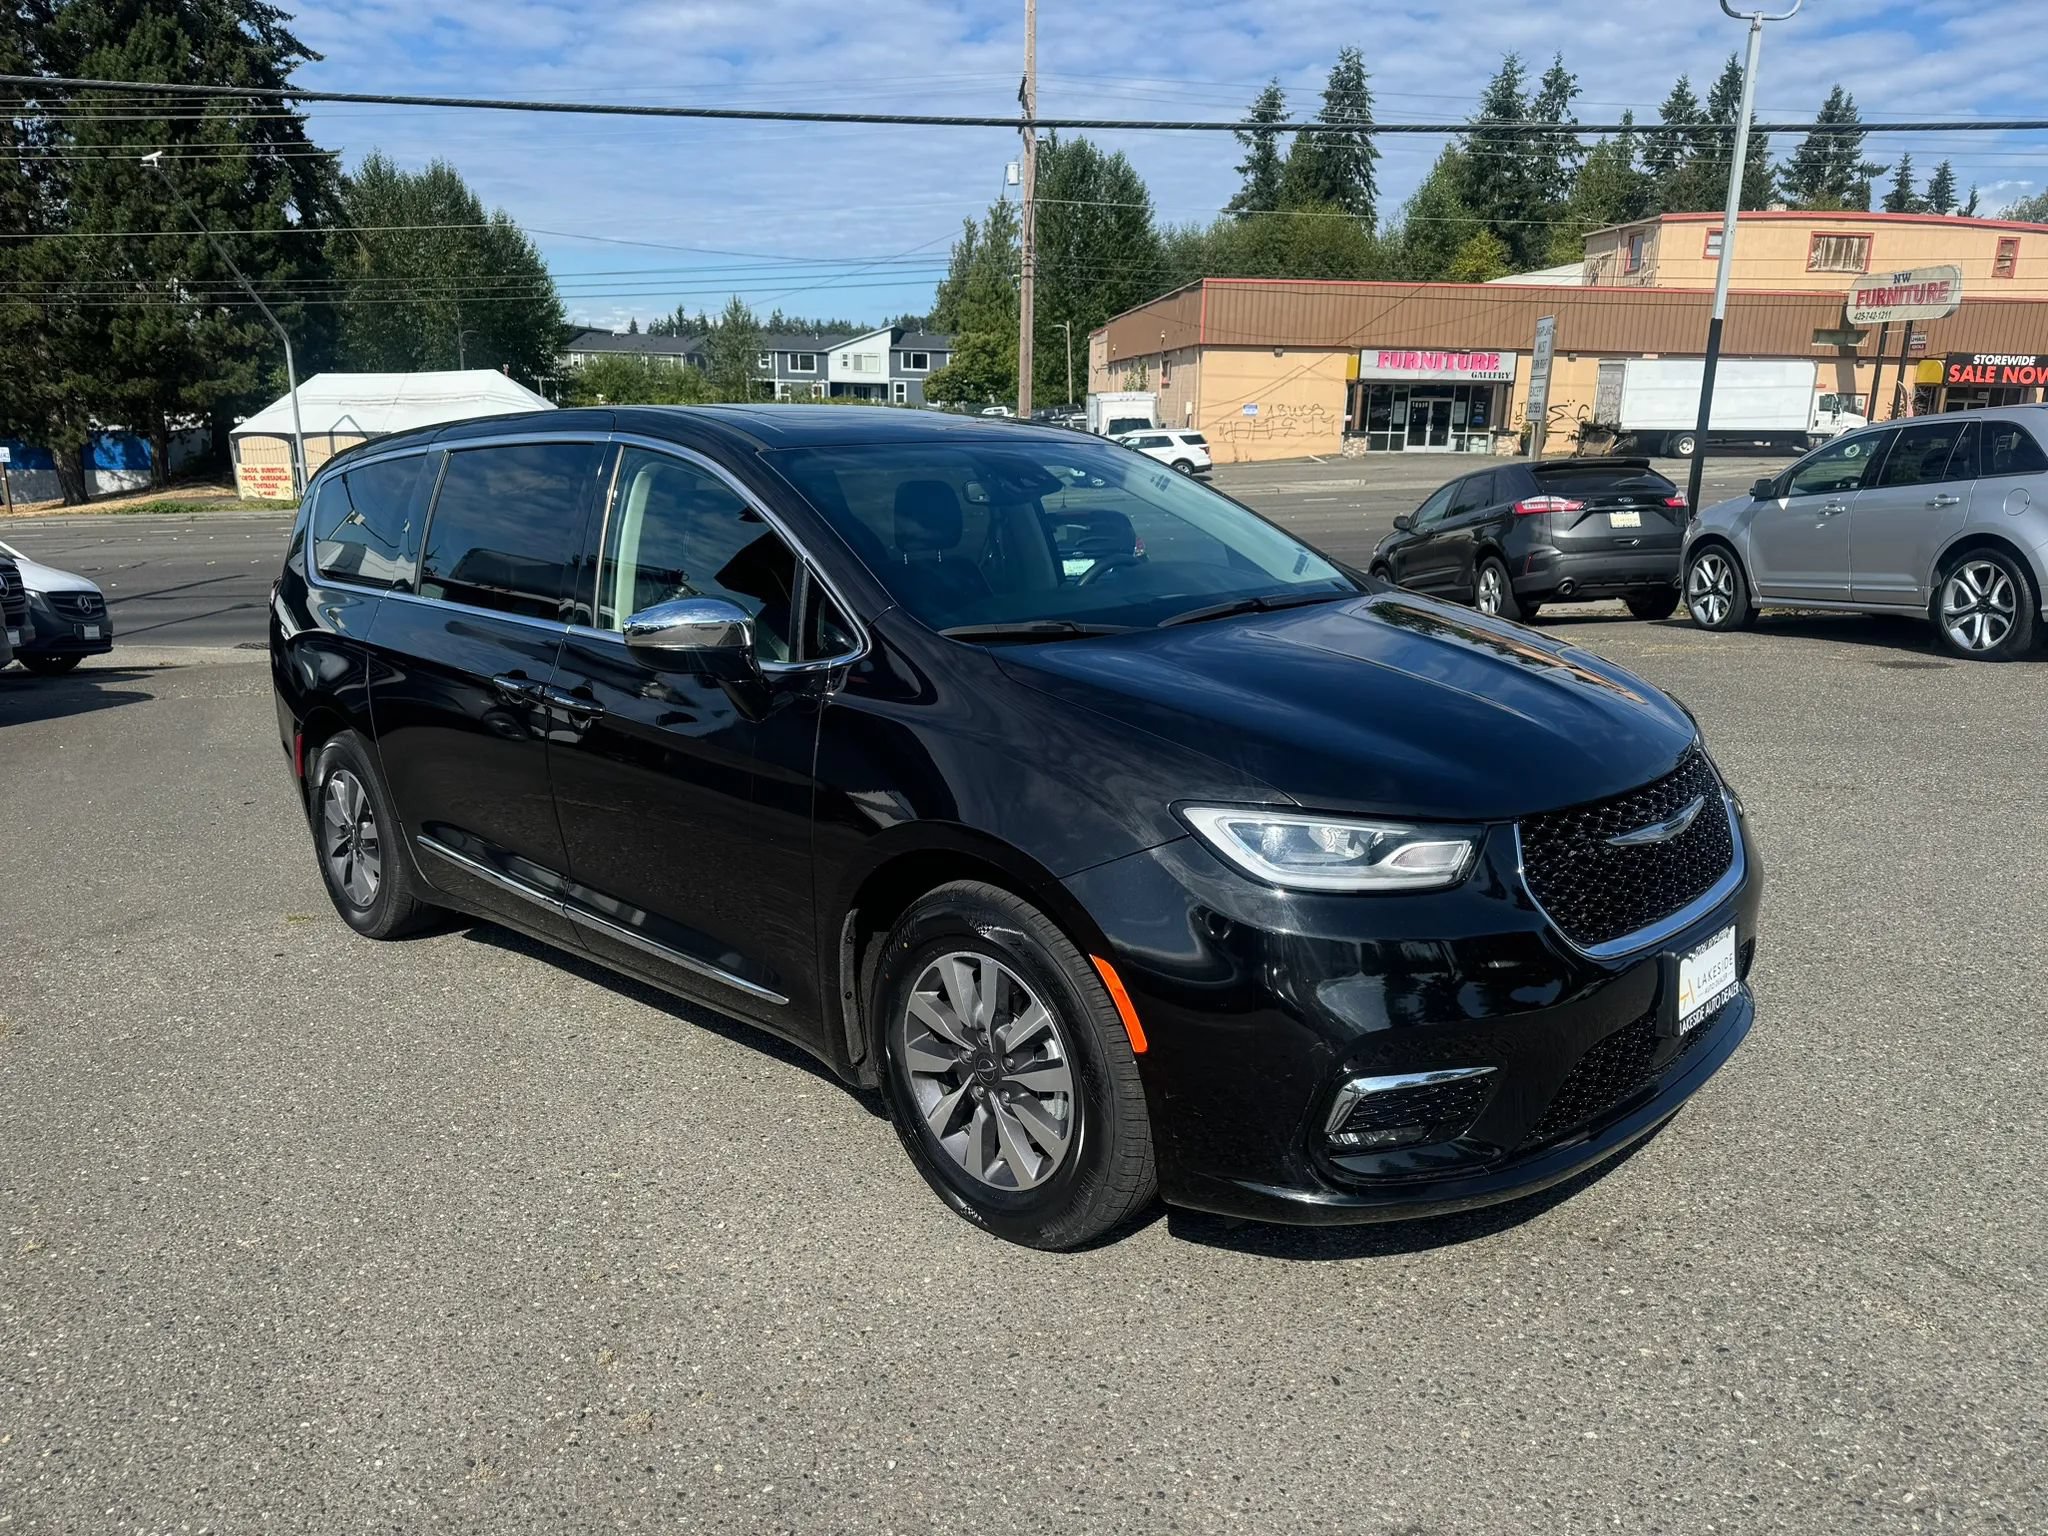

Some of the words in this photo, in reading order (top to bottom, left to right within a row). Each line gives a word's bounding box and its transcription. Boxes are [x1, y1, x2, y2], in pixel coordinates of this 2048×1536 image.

[1893, 272, 1912, 284] NW
[1856, 281, 1950, 309] FURNITURE
[1854, 311, 1892, 320] 425-742-1211
[1377, 351, 1501, 372] FURNITURE
[1973, 354, 2036, 366] STOREWIDE
[1471, 371, 1511, 380] GALLERY
[1948, 364, 1996, 384] SALE
[1697, 952, 1733, 989] LAKESIDE
[1679, 1005, 1705, 1036] LAKESIDE
[1704, 995, 1721, 1016] AUTO
[1721, 980, 1740, 1005] DEALER
